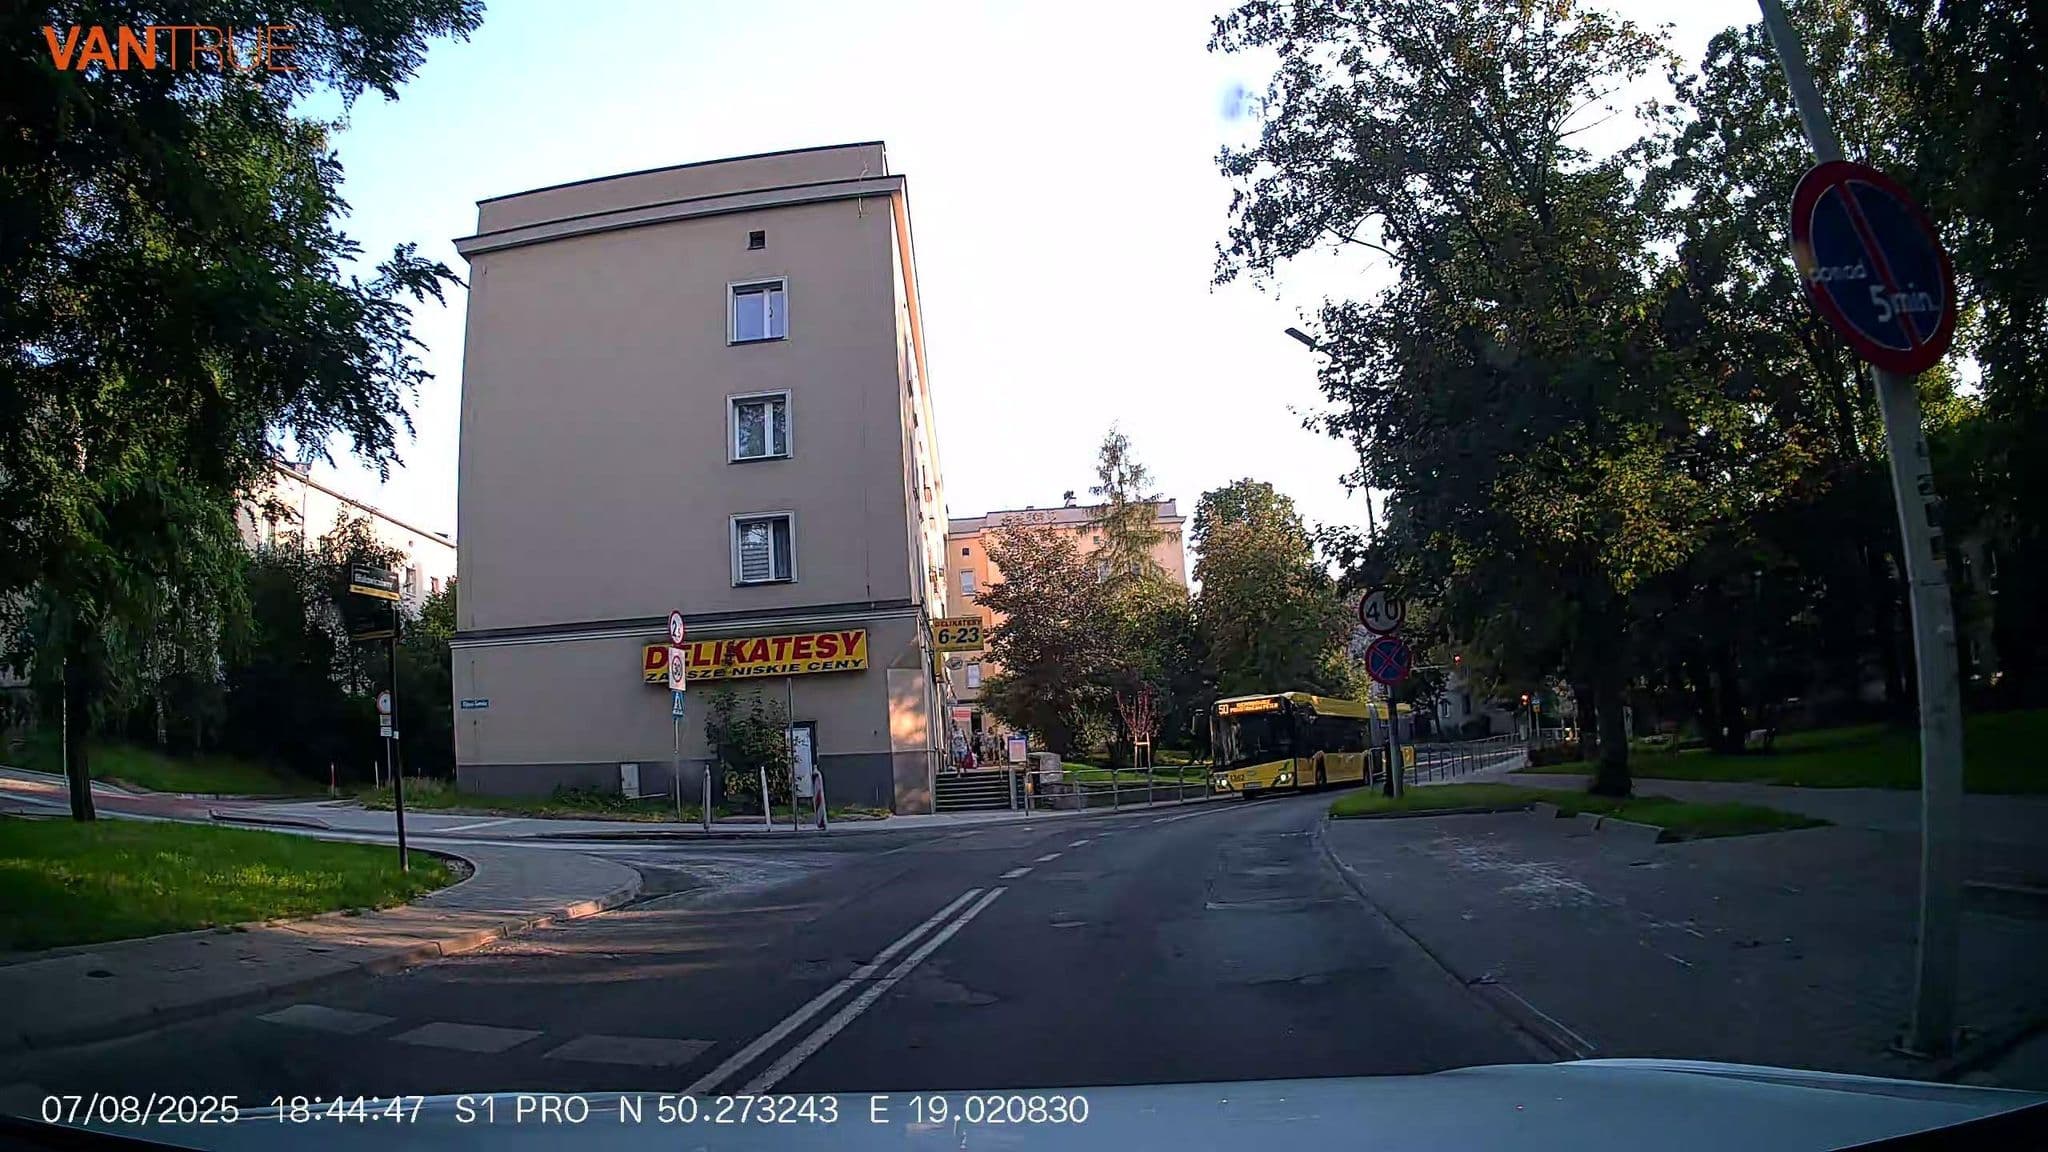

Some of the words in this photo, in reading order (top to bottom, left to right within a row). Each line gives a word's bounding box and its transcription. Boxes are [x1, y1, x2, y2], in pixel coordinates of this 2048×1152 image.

[1366, 600, 1398, 622] 40
[938, 627, 979, 644] 6-23
[645, 668, 725, 682] ZASZE
[732, 663, 800, 676] NISKIE
[807, 659, 864, 671] CENY
